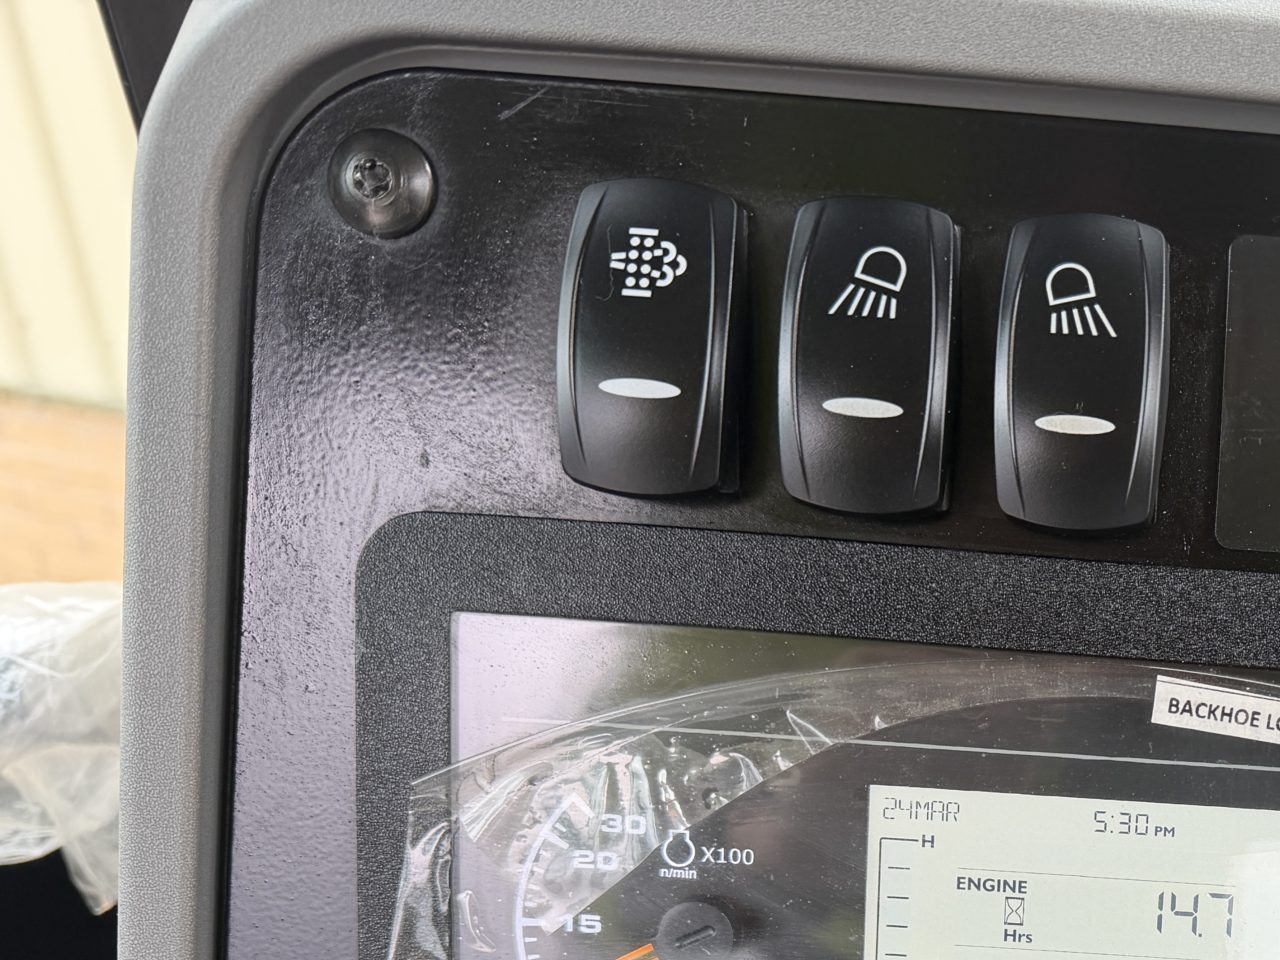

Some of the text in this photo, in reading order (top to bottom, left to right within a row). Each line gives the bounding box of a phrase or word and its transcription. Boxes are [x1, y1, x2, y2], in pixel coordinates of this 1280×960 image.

[1167, 697, 1262, 729] BACKHOE
[600, 813, 647, 835] 30
[1093, 810, 1176, 838] 5:30 PM
[921, 834, 936, 849] H
[571, 849, 620, 871] 20
[701, 846, 755, 866] X100
[658, 867, 698, 880] n/min
[955, 875, 1029, 895] ENGINE
[563, 914, 603, 934] 15
[1155, 890, 1235, 939] 14.7
[1002, 928, 1034, 945] Hrs
